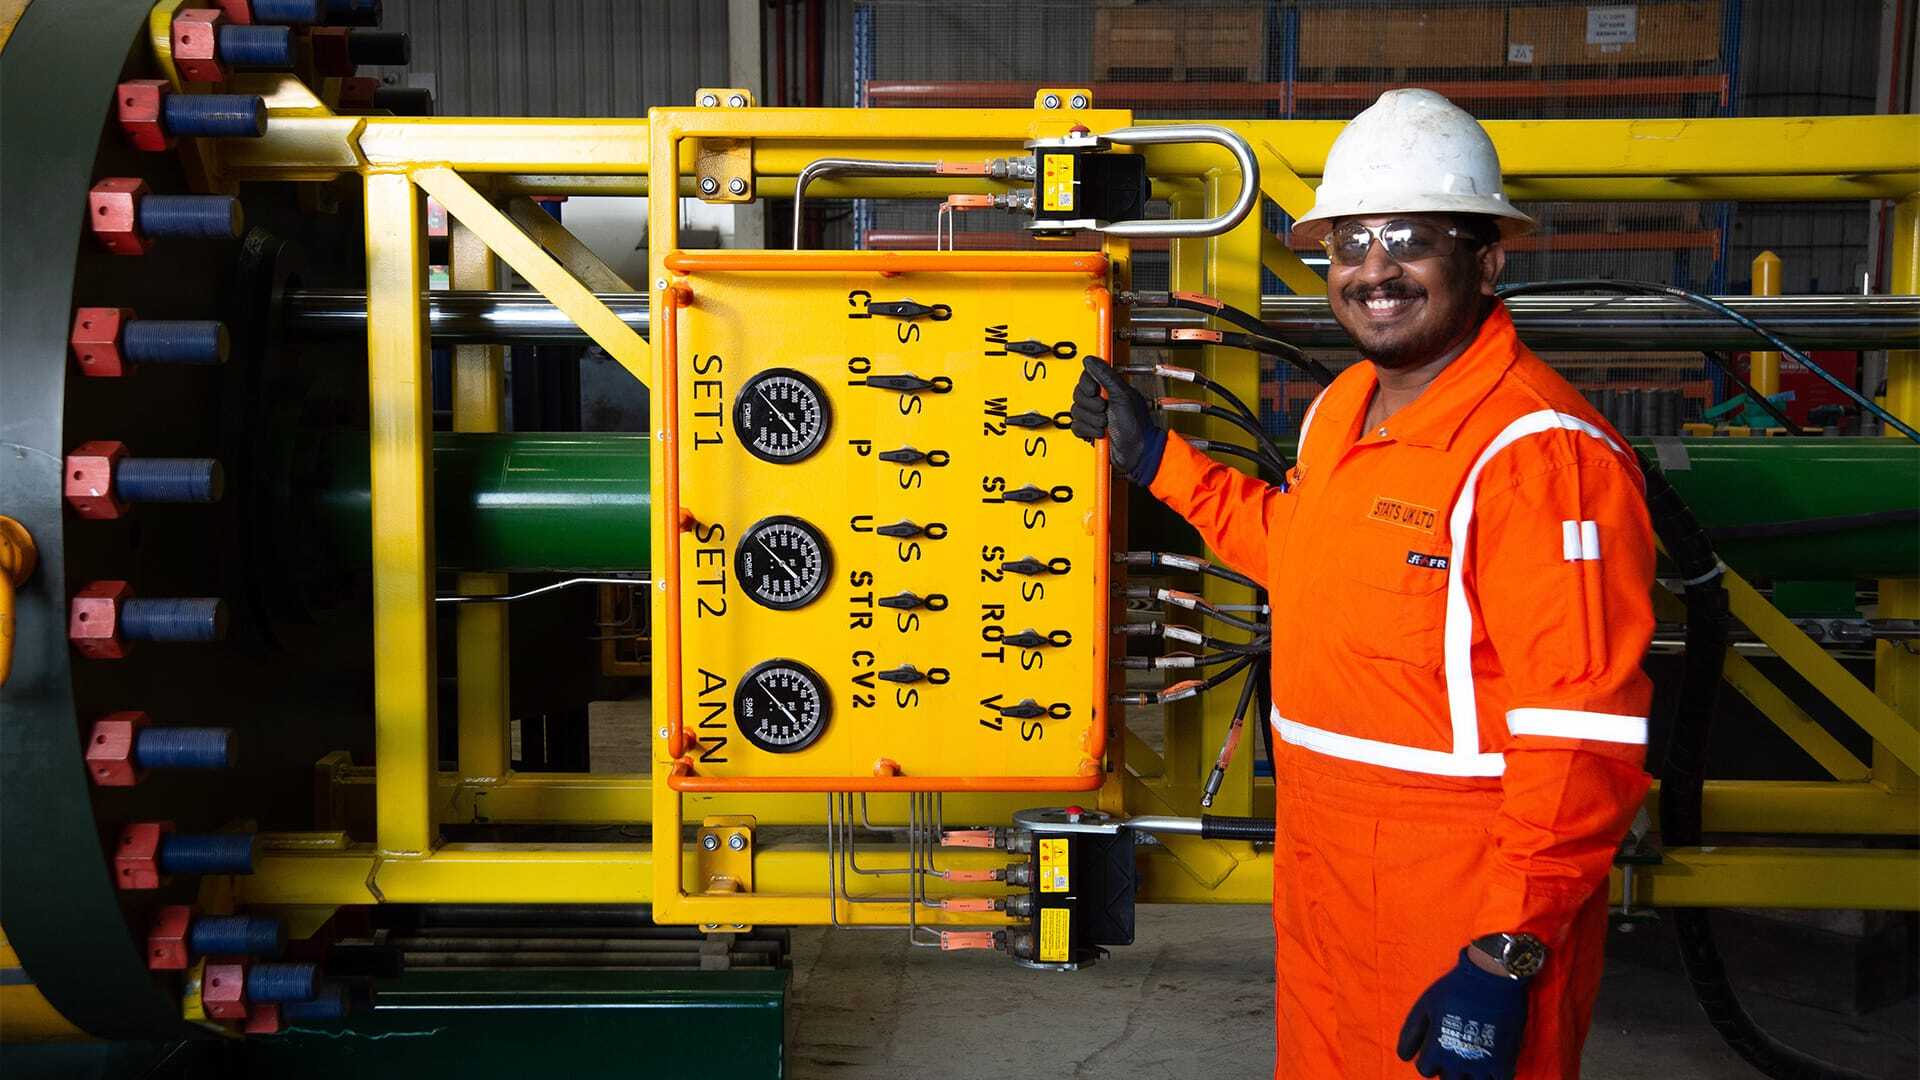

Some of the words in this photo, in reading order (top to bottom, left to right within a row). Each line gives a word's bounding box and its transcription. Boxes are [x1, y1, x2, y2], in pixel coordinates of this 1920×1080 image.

[898, 323, 919, 343] S
[1024, 361, 1046, 381] S
[693, 354, 723, 450] SET1
[899, 394, 921, 415] S
[983, 397, 1008, 436] W2
[849, 440, 871, 456] P
[1024, 437, 1047, 457] S
[899, 468, 921, 489] S
[851, 515, 873, 532] U
[1023, 509, 1045, 529] S
[1373, 501, 1402, 520] STATS
[1402, 507, 1414, 523] UK
[1414, 510, 1435, 529] LTD
[899, 542, 921, 563] S
[695, 523, 727, 618] SET2
[981, 545, 1005, 583] S2
[850, 570, 873, 630] STR
[1022, 581, 1044, 602] S
[897, 613, 919, 633] S
[981, 604, 1005, 663] ROT
[1020, 649, 1043, 670] S
[851, 650, 876, 708] CV2
[896, 688, 918, 708] S
[697, 669, 728, 763] ANN
[1020, 721, 1043, 742] S
